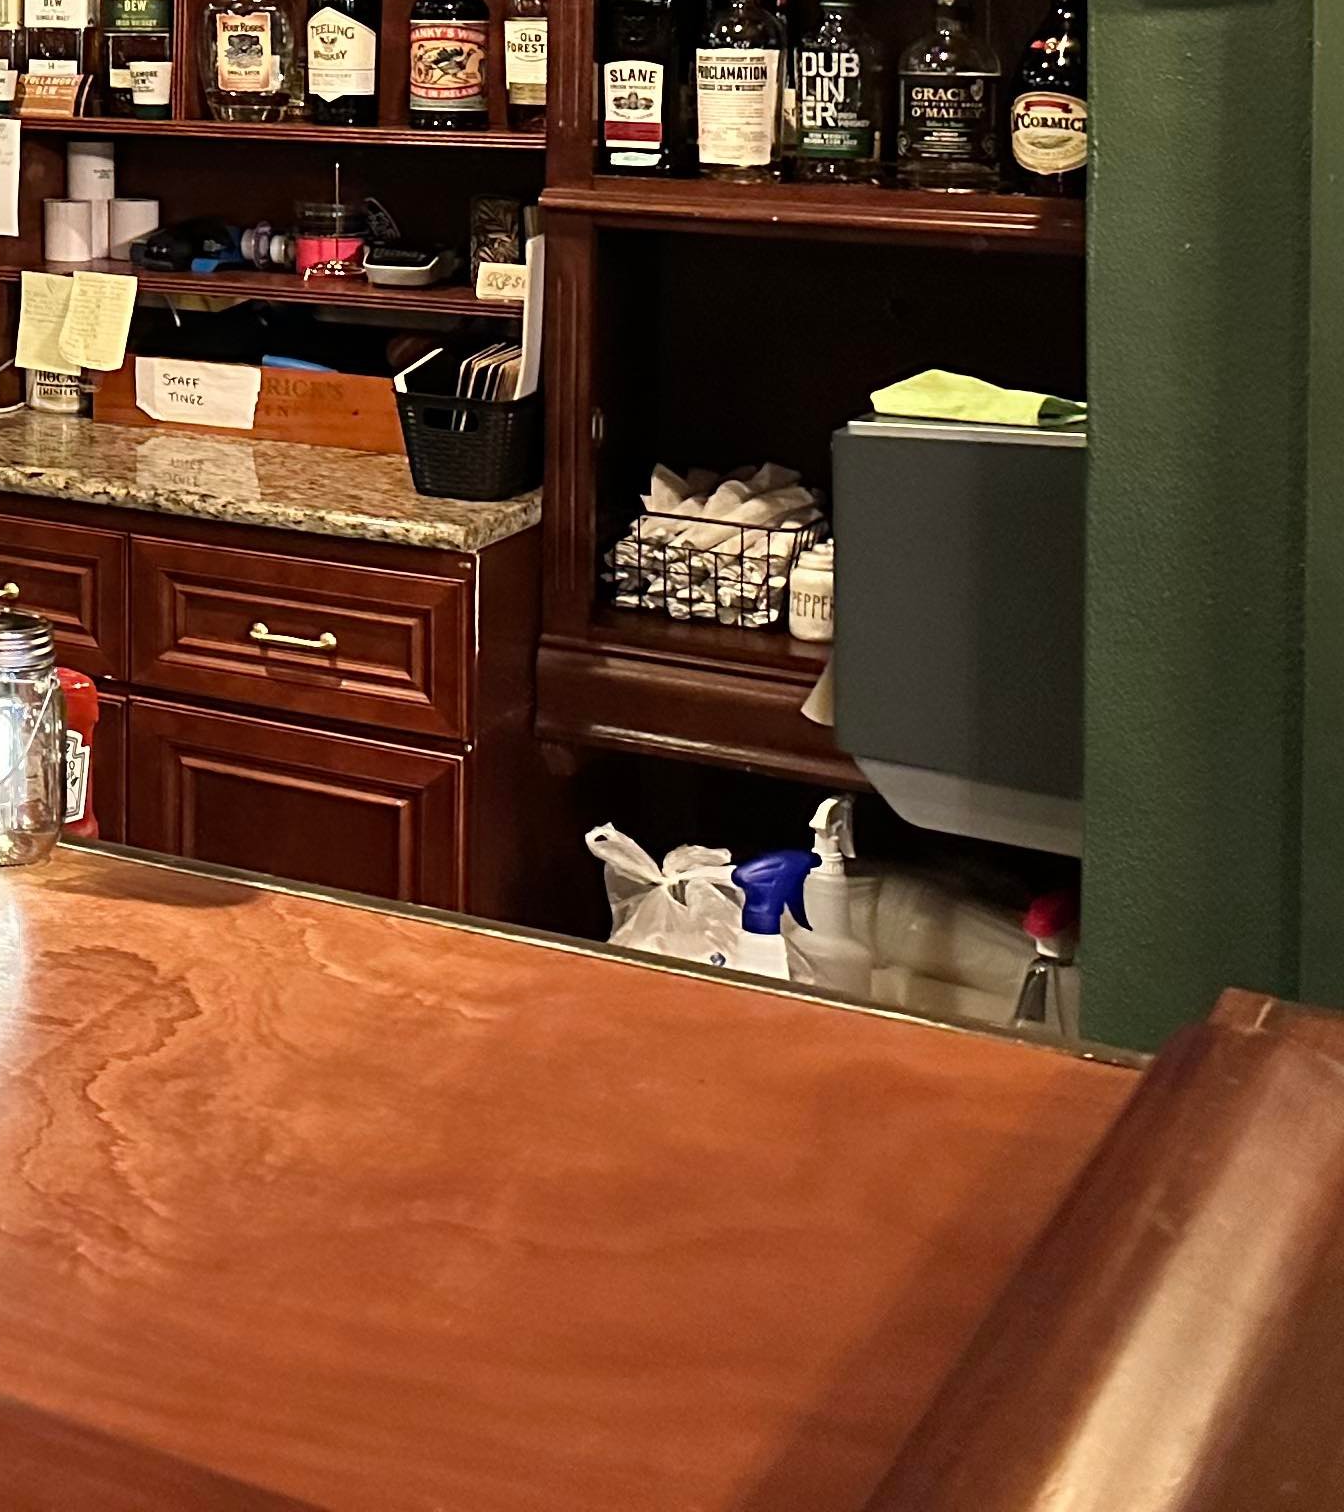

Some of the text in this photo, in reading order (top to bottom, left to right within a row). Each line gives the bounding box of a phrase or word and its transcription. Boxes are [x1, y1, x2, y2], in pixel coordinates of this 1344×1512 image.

[123, 0, 147, 12] DEW
[310, 23, 355, 39] TEELING
[414, 28, 455, 39] ANKY'S
[520, 32, 542, 43] OLD
[506, 40, 546, 54] FOREST
[698, 64, 768, 81] PROCLAMATION
[801, 52, 860, 78] DUB
[609, 69, 658, 84] SLANE
[801, 77, 845, 103] LIN
[801, 102, 836, 127] ER
[162, 373, 200, 389] STAFF
